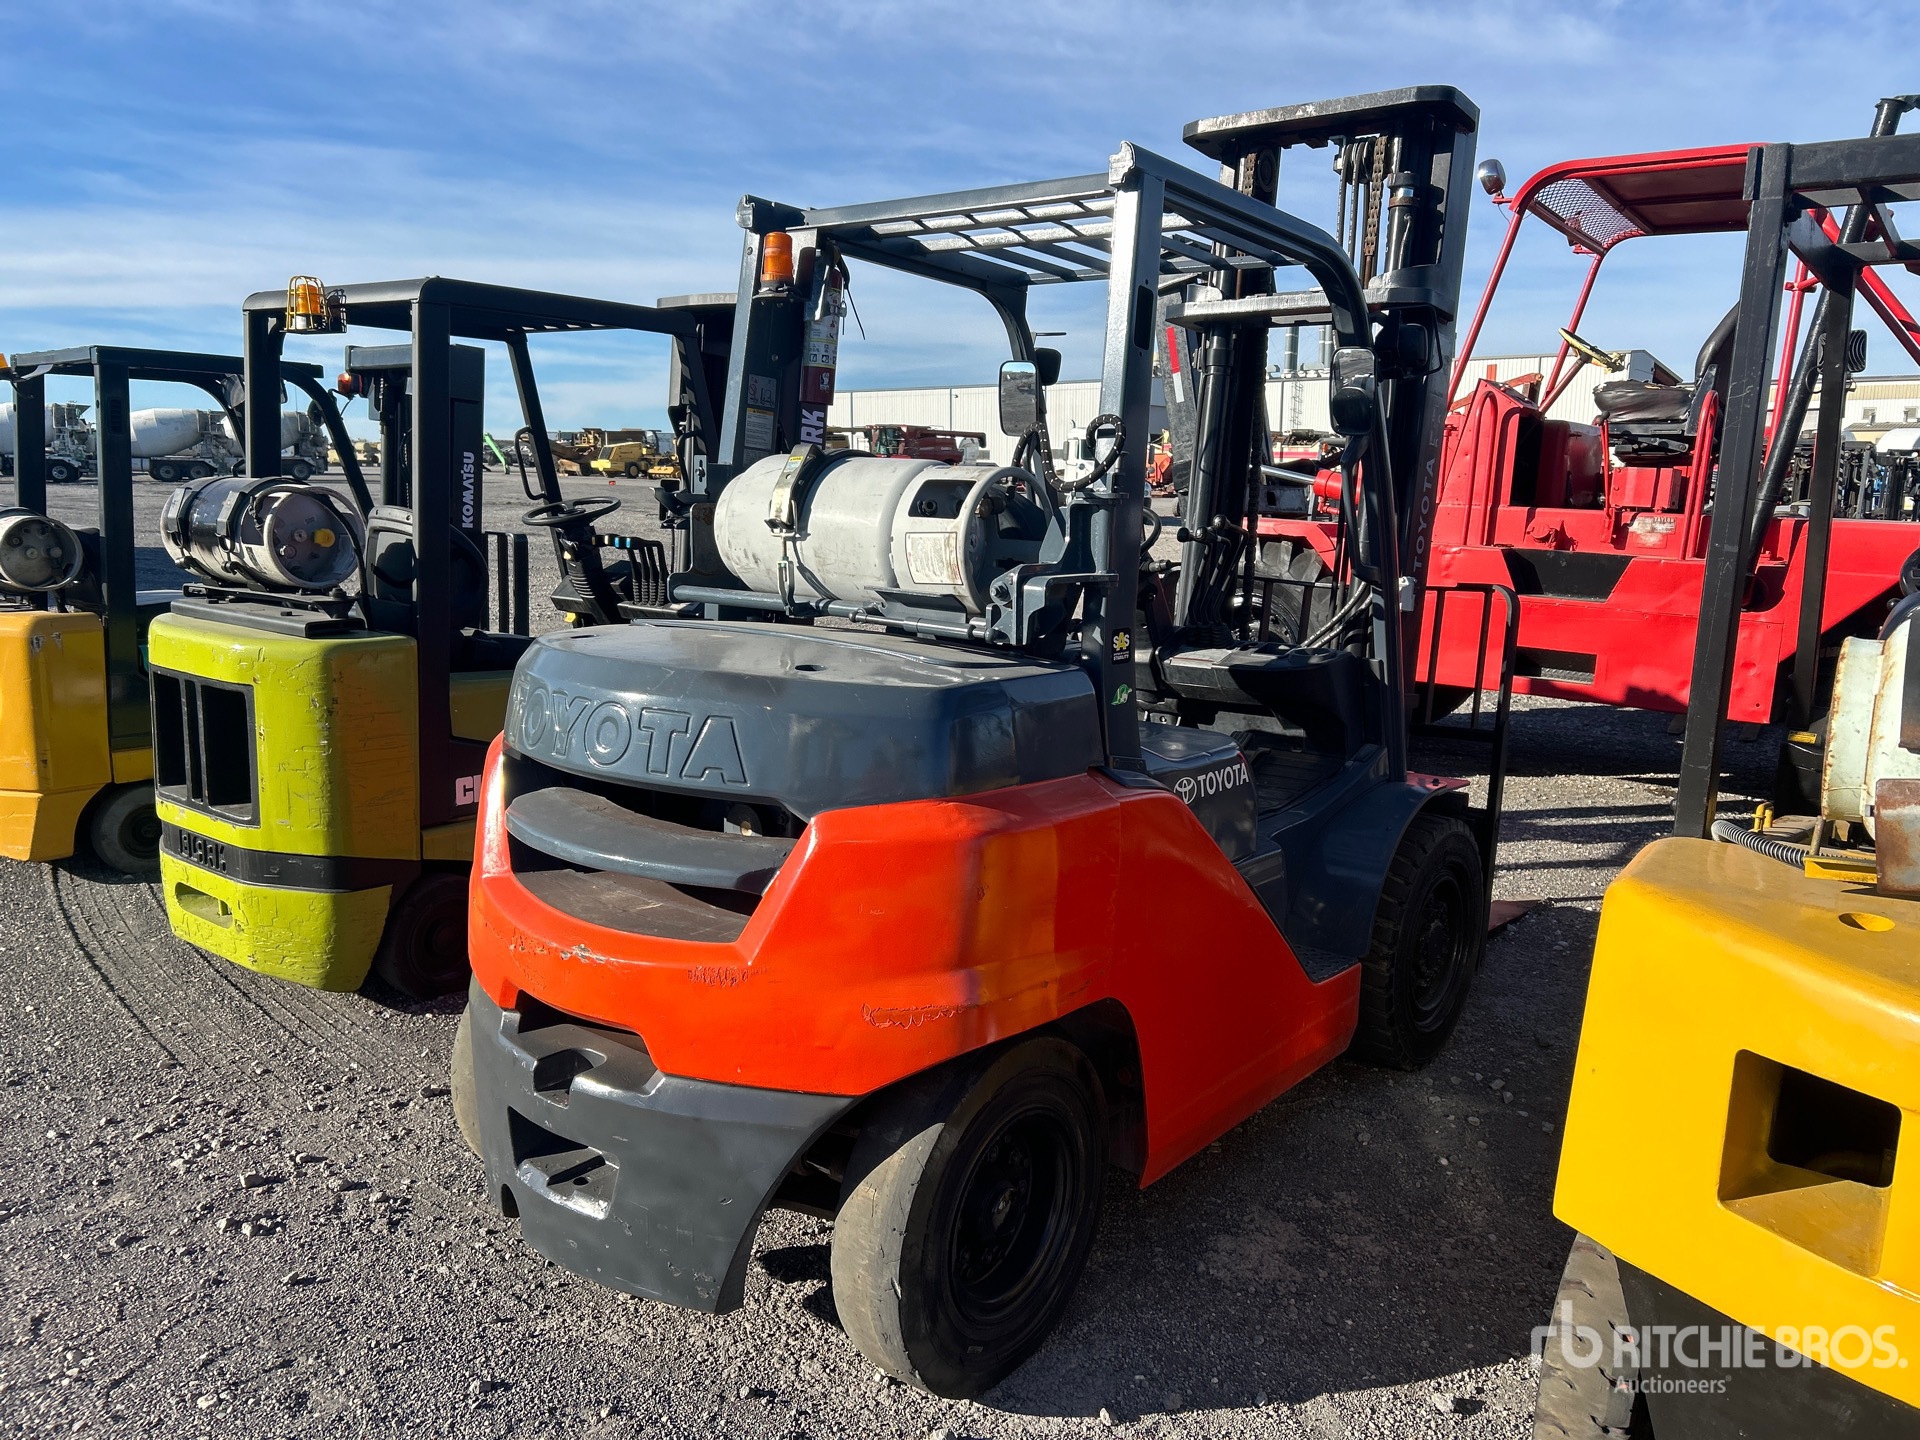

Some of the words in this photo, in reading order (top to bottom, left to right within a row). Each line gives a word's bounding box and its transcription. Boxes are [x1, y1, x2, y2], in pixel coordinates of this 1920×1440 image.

[461, 451, 475, 529] KOMATSU
[1413, 457, 1436, 573] TOYOTA
[1112, 631, 1130, 651] SAS
[507, 679, 751, 788] TOYOTA
[1197, 762, 1250, 798] TOYOTA
